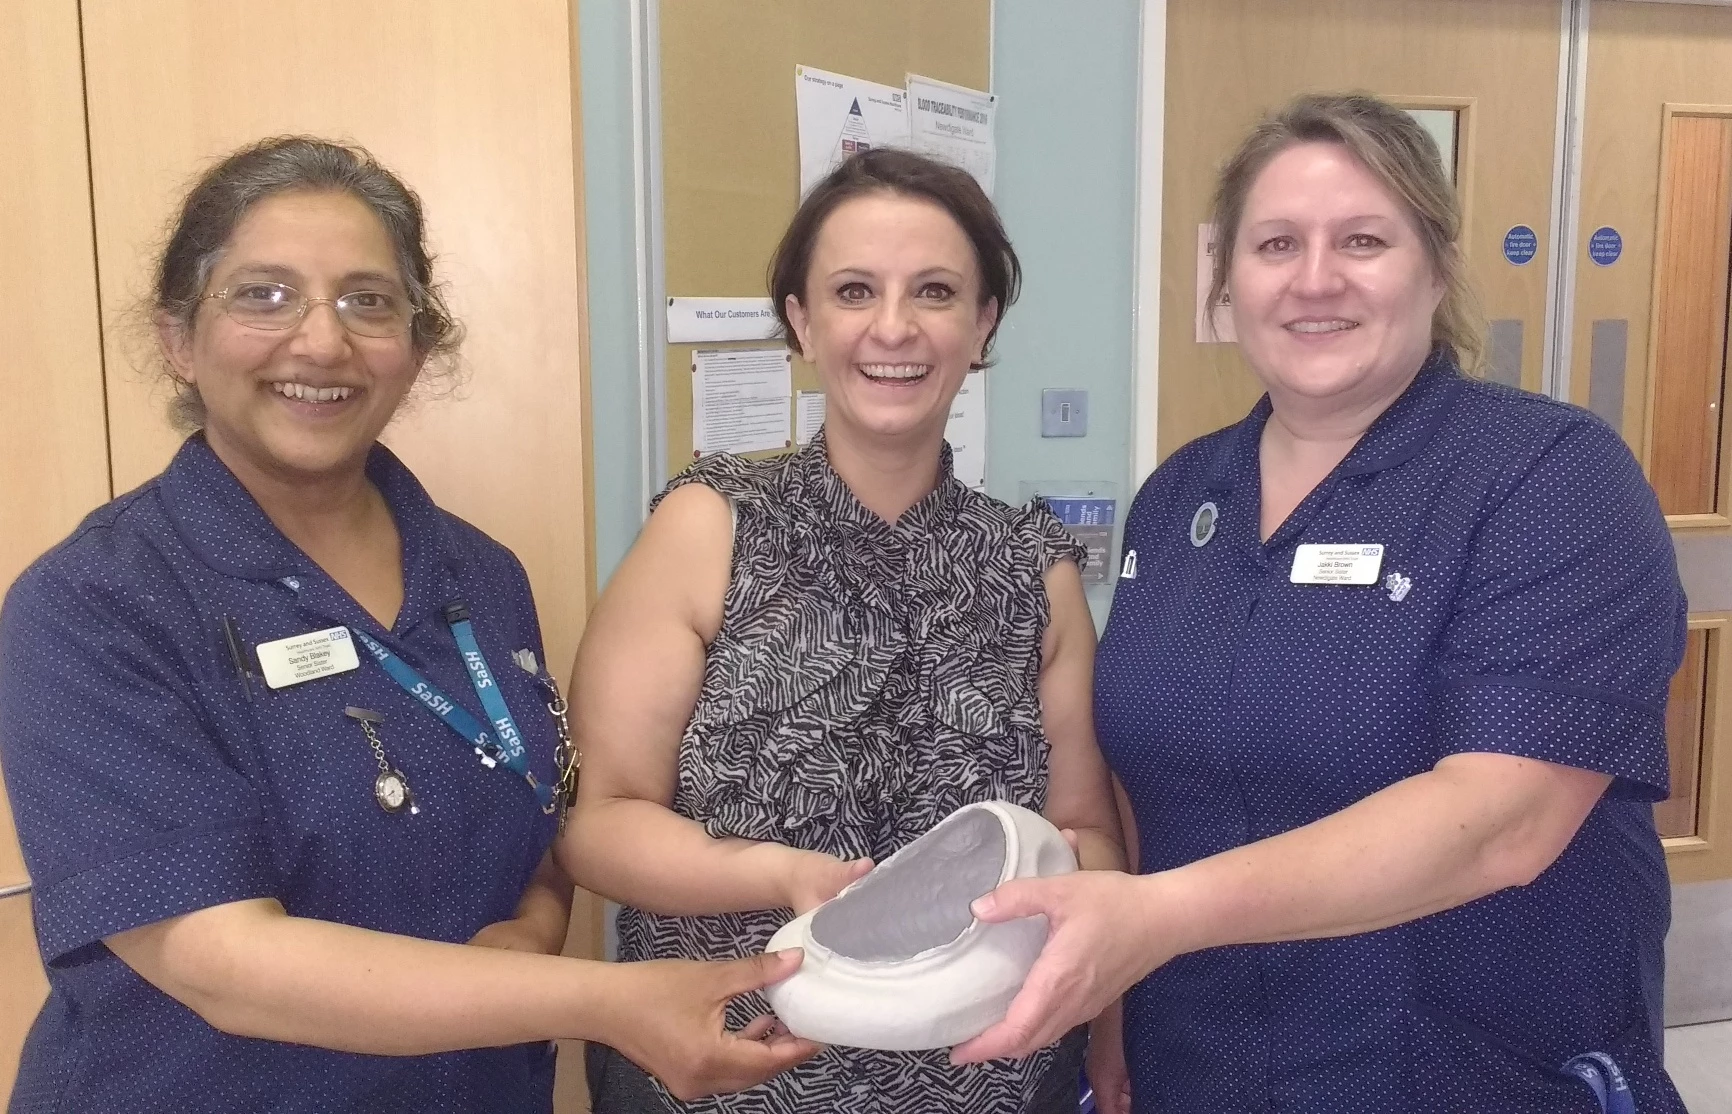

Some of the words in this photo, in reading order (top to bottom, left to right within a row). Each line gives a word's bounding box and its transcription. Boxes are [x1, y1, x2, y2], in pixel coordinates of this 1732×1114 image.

[812, 76, 826, 86] strategy
[918, 98, 930, 112] BLOOD
[931, 100, 957, 117] TRACEABILITY
[696, 311, 713, 319] What
[714, 310, 726, 318] Our
[728, 310, 759, 318] Customers
[1362, 548, 1380, 556] NHS
[286, 642, 302, 651] Surrey
[330, 630, 348, 641] NHS
[289, 655, 308, 664] Sandy
[310, 650, 330, 660] Blakey
[295, 668, 320, 678] Woodland
[465, 651, 492, 689] SaSH
[410, 682, 454, 716] SaSH
[496, 717, 526, 757] SaSH
